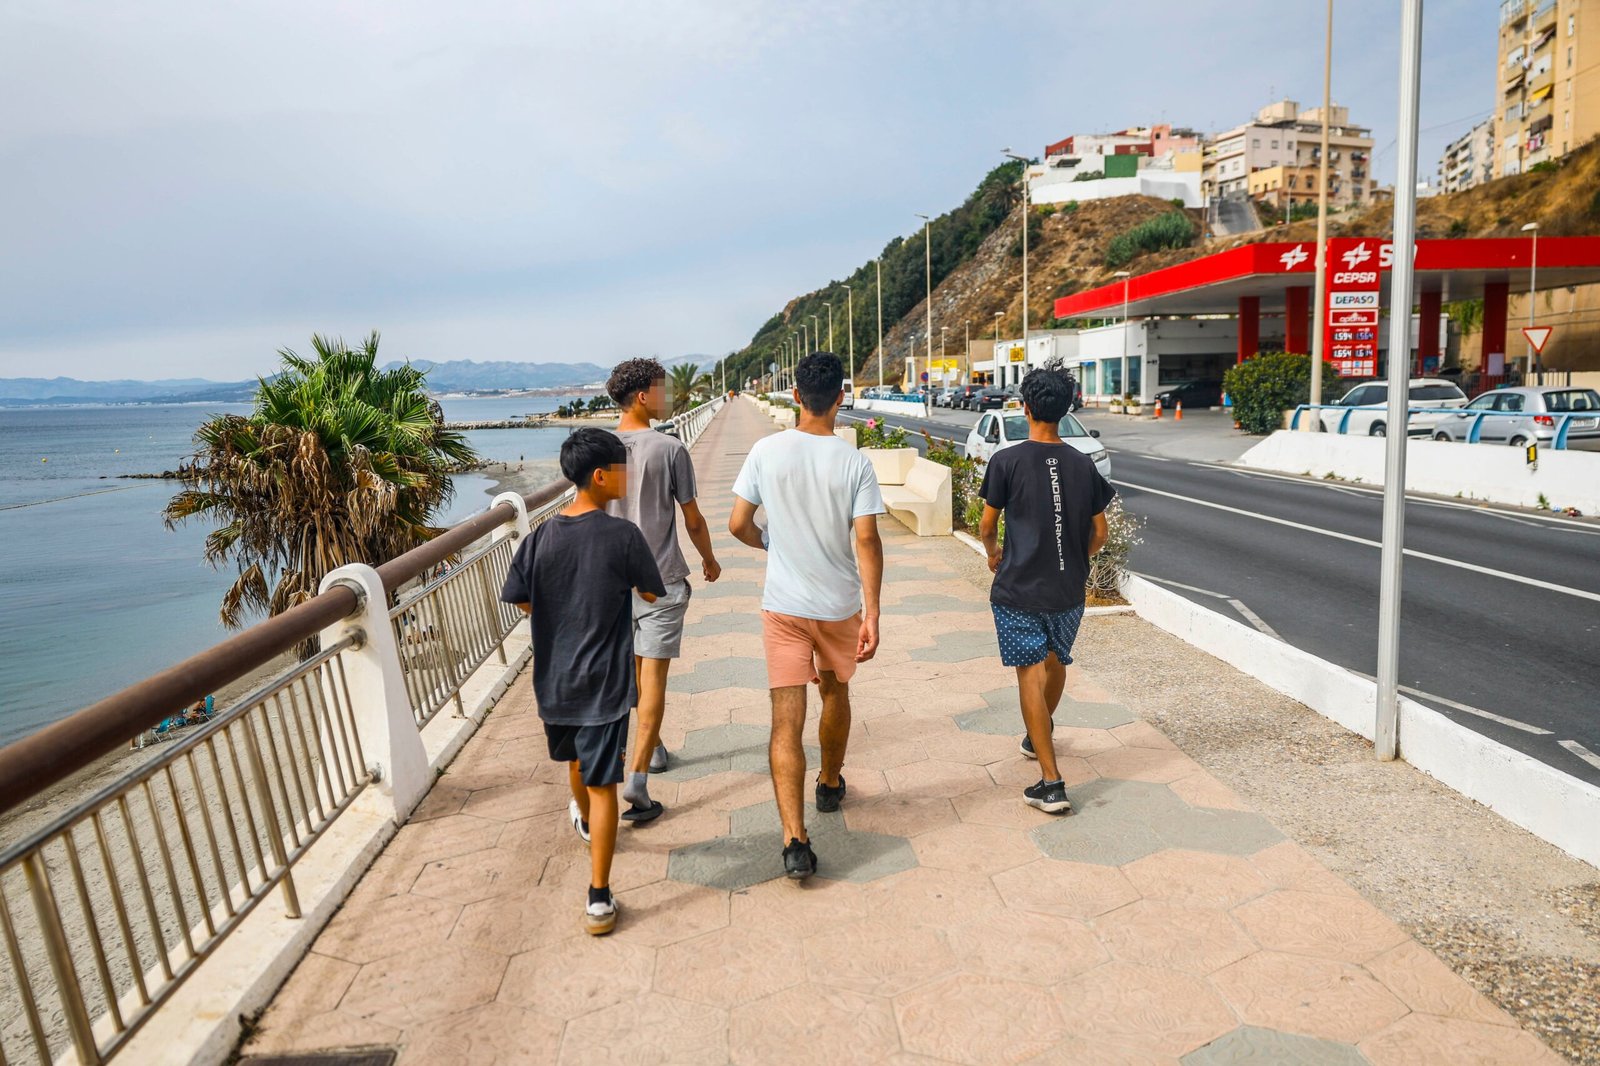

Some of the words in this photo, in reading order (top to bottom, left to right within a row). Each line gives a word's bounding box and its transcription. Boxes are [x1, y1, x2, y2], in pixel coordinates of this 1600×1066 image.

[1333, 272, 1377, 284] CEPSA
[1335, 295, 1375, 305] DEPASO
[1050, 467, 1062, 512] UNDER
